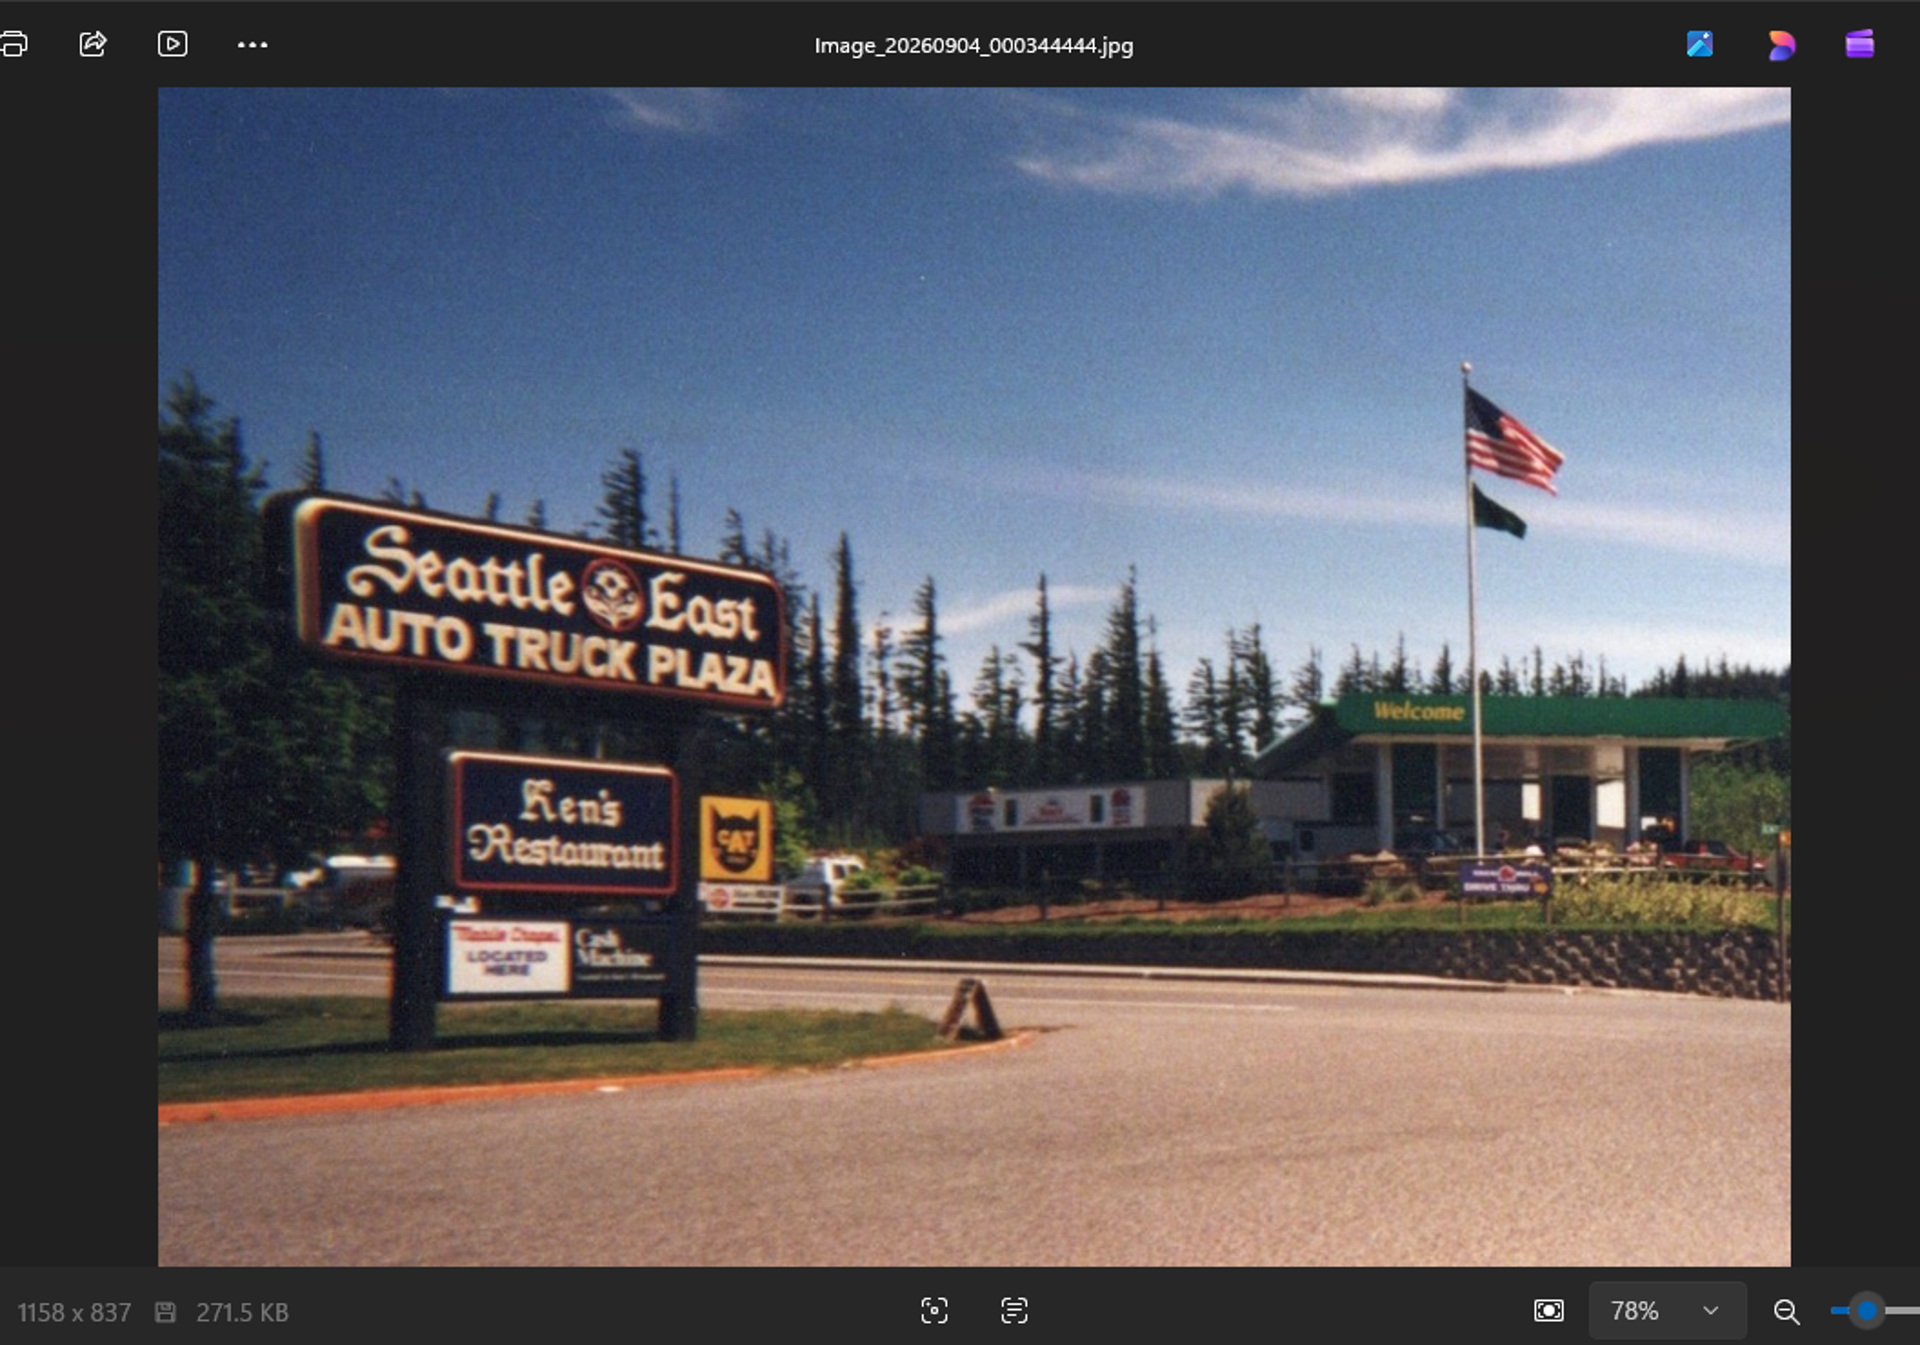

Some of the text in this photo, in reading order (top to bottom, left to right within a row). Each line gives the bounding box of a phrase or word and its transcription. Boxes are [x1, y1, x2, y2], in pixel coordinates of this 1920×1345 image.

[346, 525, 760, 641] Seattle East
[323, 603, 778, 698] AUTO TRUCK PLAZA
[1374, 700, 1465, 720] Welcome
[518, 778, 622, 828] Ken's
[467, 823, 665, 870] Restaurant
[717, 828, 758, 854] CAT
[575, 928, 621, 948] Cash
[466, 950, 548, 963] LOCATED
[576, 948, 652, 967] Machine
[484, 964, 531, 977] HERE
